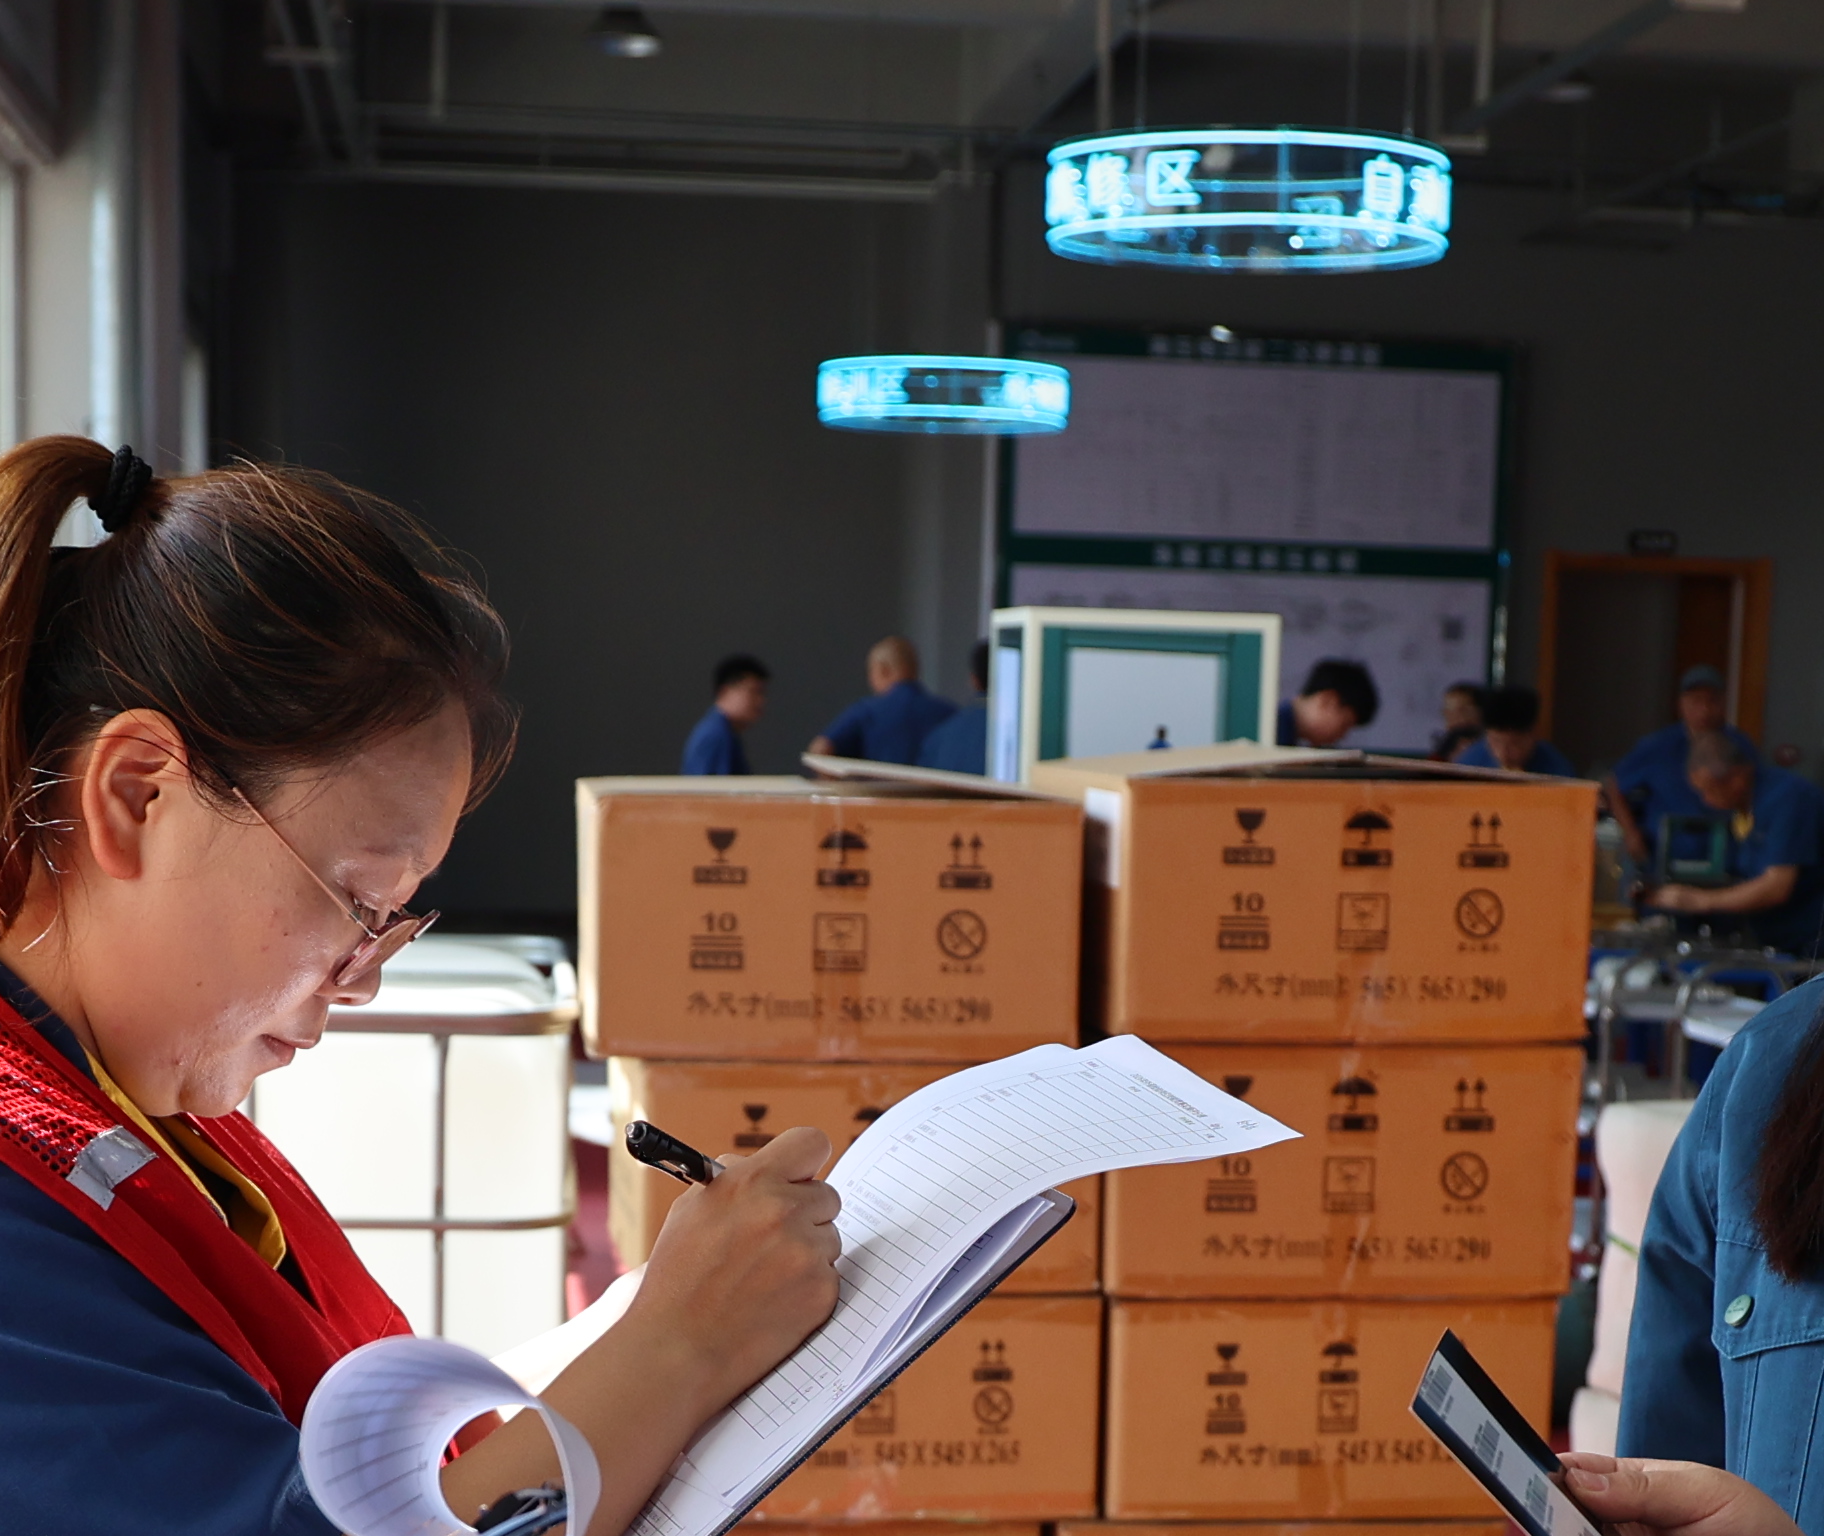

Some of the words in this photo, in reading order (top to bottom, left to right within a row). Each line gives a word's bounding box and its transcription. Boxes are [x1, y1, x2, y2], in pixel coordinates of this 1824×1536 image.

[1233, 892, 1265, 912] 10
[702, 912, 738, 932] 10
[1219, 1157, 1251, 1176] 10
